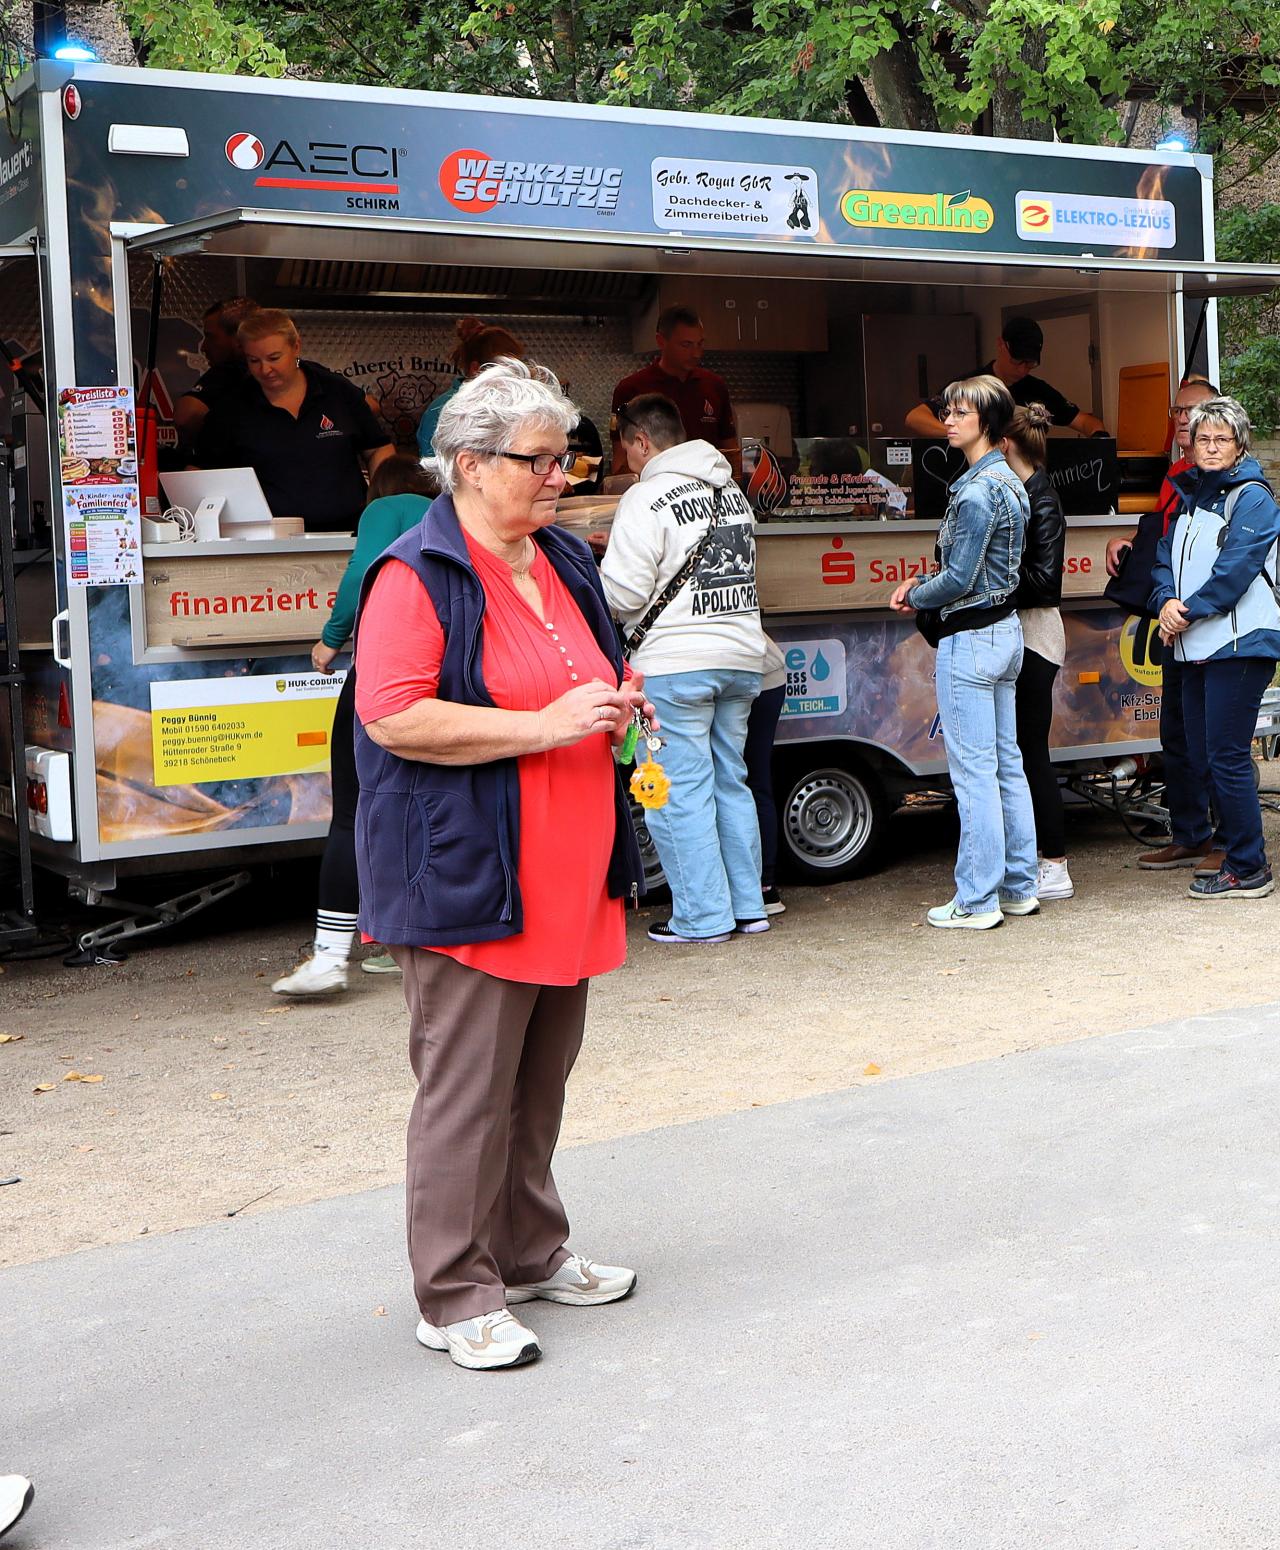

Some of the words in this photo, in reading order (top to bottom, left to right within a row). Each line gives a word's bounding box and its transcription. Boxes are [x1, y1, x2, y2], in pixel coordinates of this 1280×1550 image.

[457, 158, 623, 188] WERKZEUG
[656, 169, 691, 186] Gebr.
[739, 175, 772, 192] GbR
[453, 178, 620, 209] SCHULTZE
[346, 197, 400, 210] SCHIRM
[669, 195, 750, 209] Dachdecker-
[753, 200, 763, 209] &
[664, 208, 769, 223] Zimmereibetrieb
[845, 192, 990, 229] Greenline
[1055, 209, 1171, 230] ELEKTRO-LEZIUS
[410, 356, 462, 375] Brink
[75, 389, 115, 403] Preisliste
[789, 475, 829, 485] Freunde
[830, 474, 839, 485] &
[650, 496, 669, 513] THE
[665, 480, 705, 500] REMATCH
[790, 486, 804, 495] der
[830, 485, 844, 495] und
[76, 499, 128, 509] Familienfest
[790, 496, 804, 506] der
[804, 495, 824, 506] Stadt
[670, 496, 713, 527] ROCKY
[169, 587, 319, 617] finanziert
[691, 587, 740, 616] APOLLO
[739, 584, 758, 609] CRE
[786, 672, 807, 684] ESS
[1134, 668, 1162, 676] autoser
[288, 677, 344, 688] HUK-COBURG
[786, 684, 808, 696] OHG
[1121, 693, 1161, 708] Kfz-Se
[161, 716, 187, 725] Peggy
[188, 713, 217, 722] Bünnig
[161, 726, 183, 735] Mobil
[185, 724, 210, 733] 01590
[210, 744, 235, 753] Straße
[236, 743, 242, 751] 9
[190, 755, 236, 765] Schönebeck
